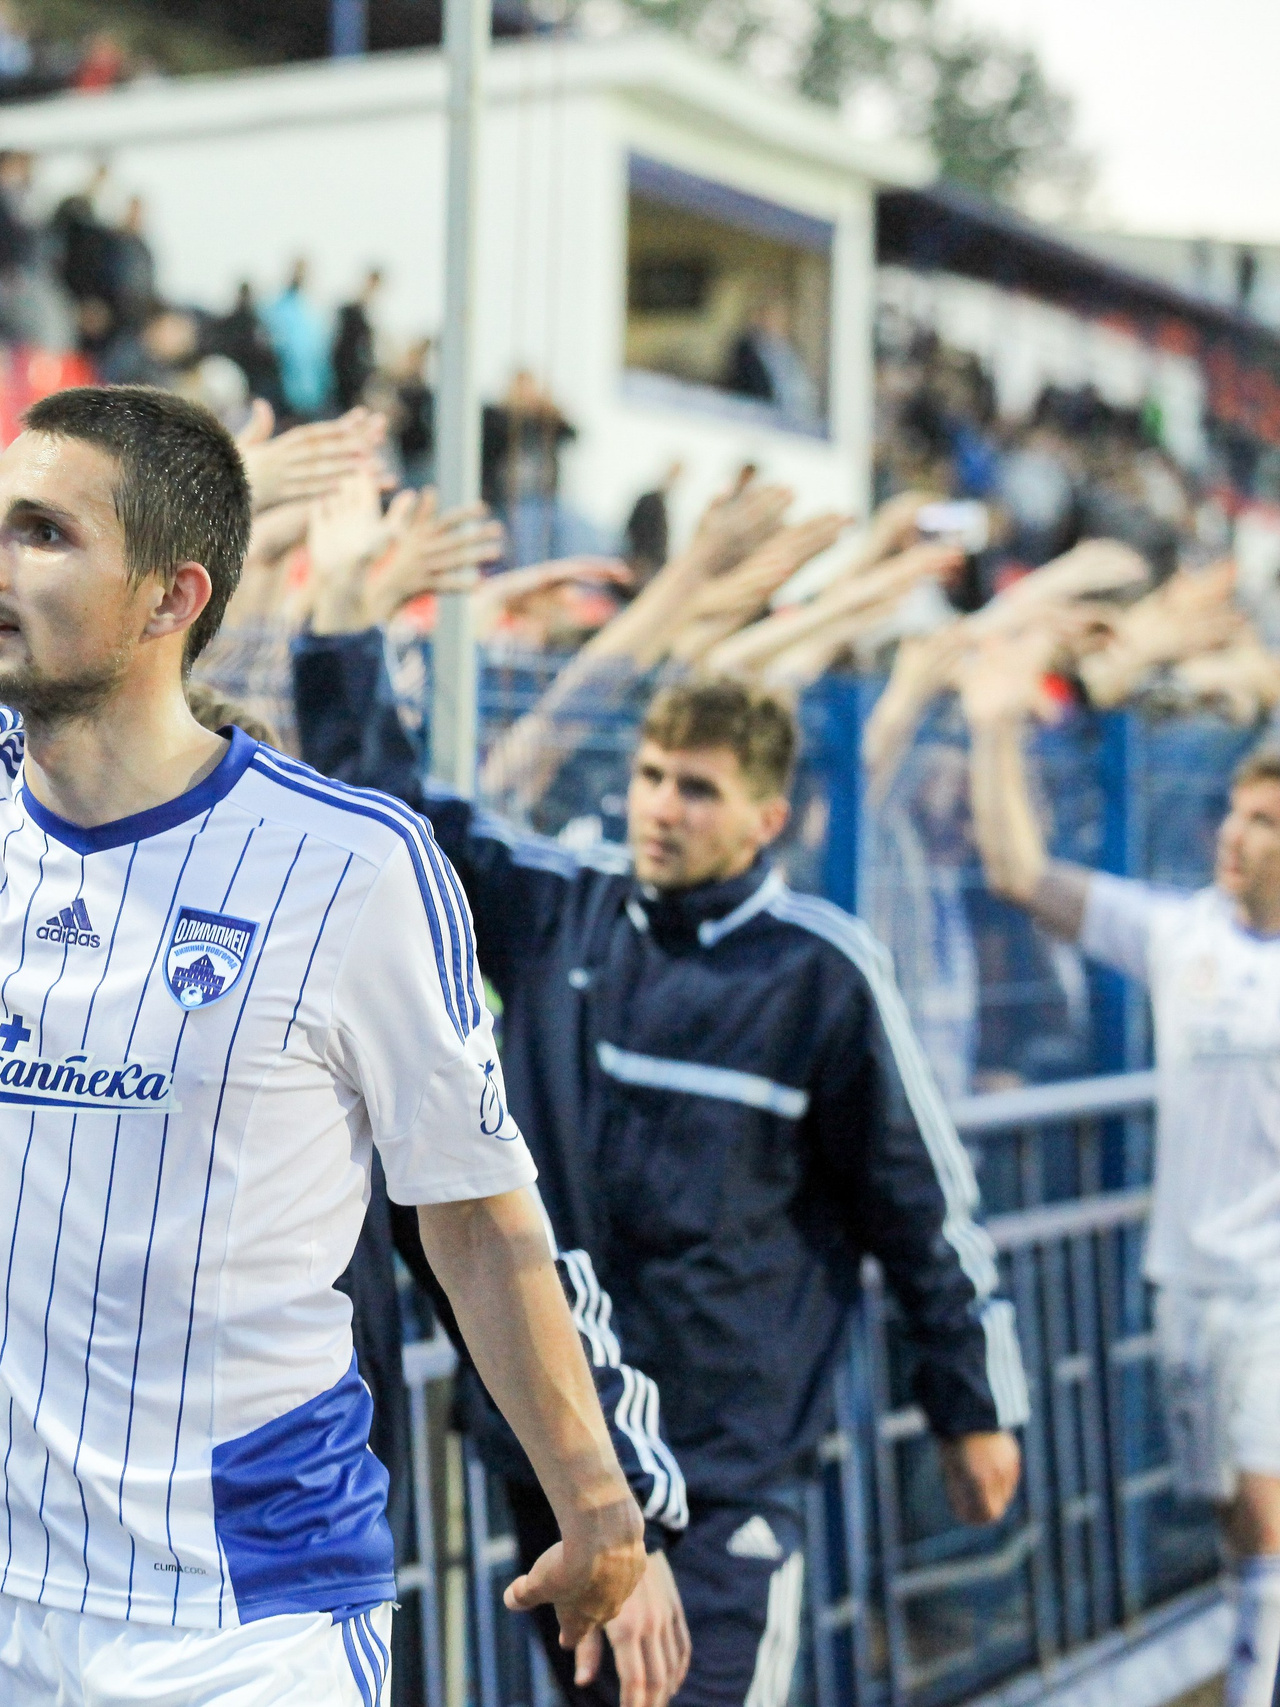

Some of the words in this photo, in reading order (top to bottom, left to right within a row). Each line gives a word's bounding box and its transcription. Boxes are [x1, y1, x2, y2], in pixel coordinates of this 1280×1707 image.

[36, 926, 100, 948] adidas
[175, 918, 250, 961] ОЛИМПИЕЦ
[154, 1563, 208, 1575] CLIMACOOL
